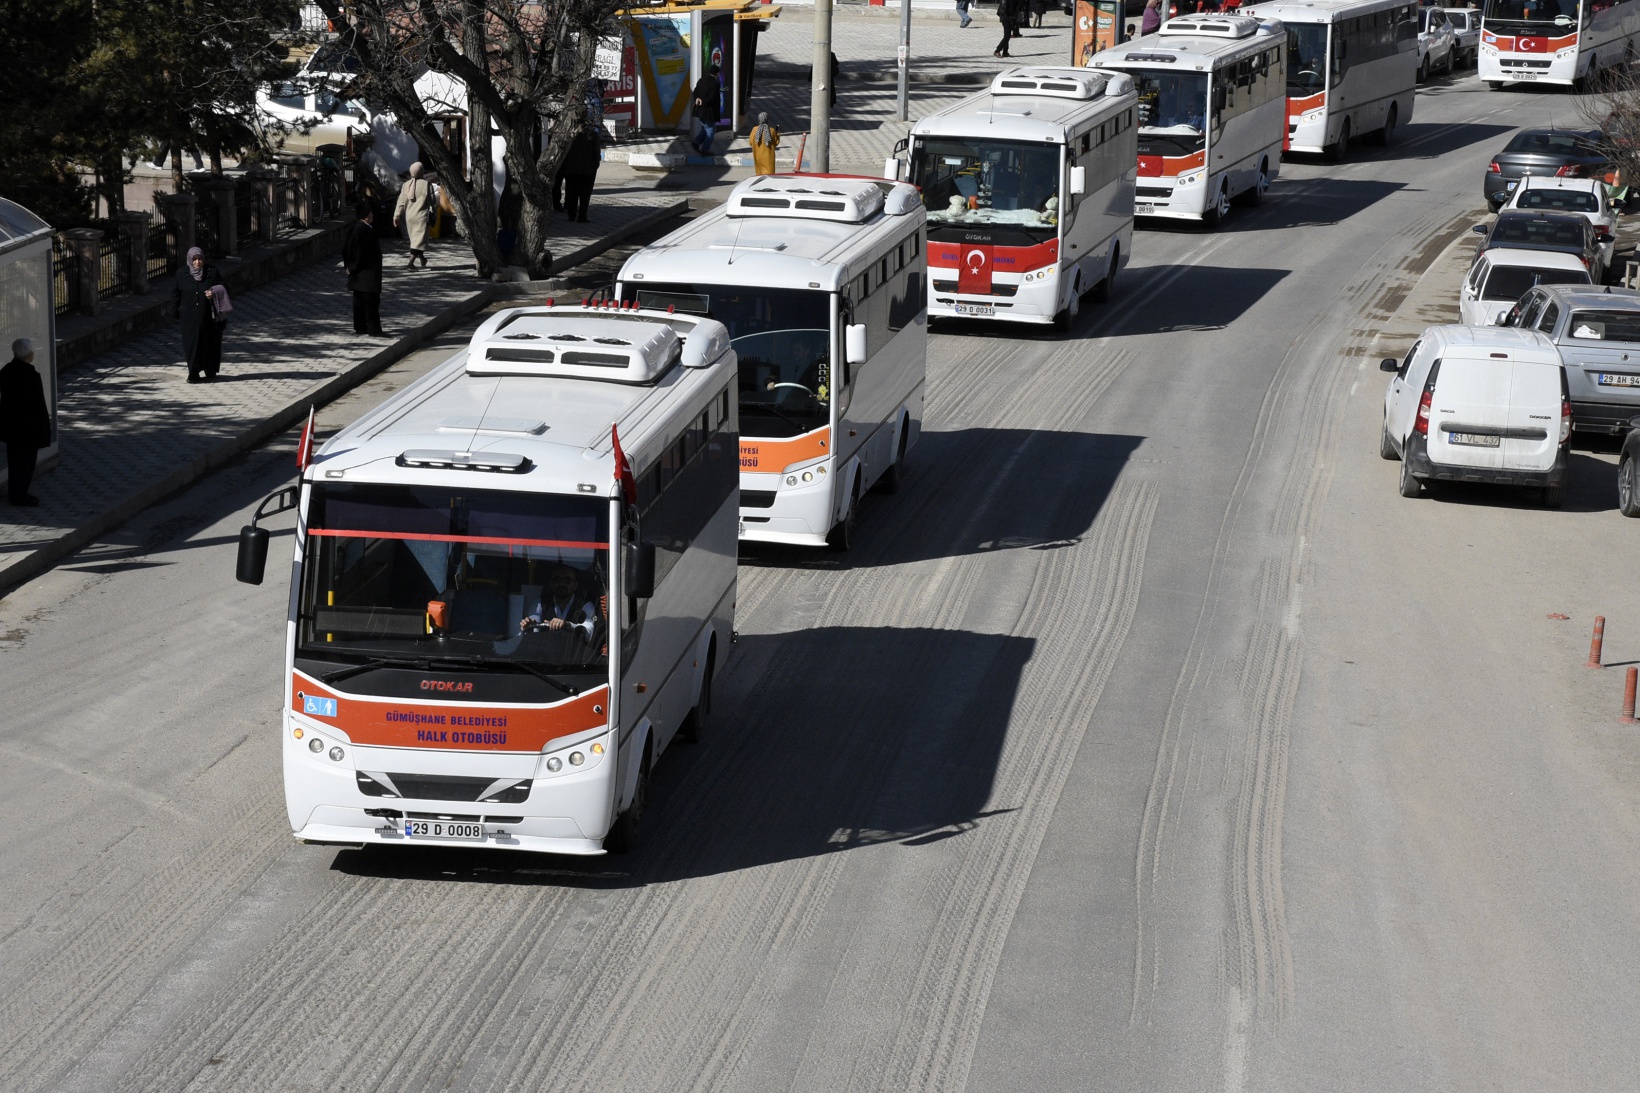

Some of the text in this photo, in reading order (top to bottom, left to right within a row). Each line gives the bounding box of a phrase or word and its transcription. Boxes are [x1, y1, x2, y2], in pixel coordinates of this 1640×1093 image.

[1603, 375, 1614, 383] 29
[1616, 376, 1627, 384] AH
[1453, 433, 1463, 442] 61
[420, 680, 474, 693] OTOKAR
[386, 710, 507, 727] GÜMÜŞHANE BELEDİYESİ
[417, 730, 507, 745] HALK OTOBÜSÜ
[412, 822, 429, 835] 29
[434, 823, 442, 836] D
[447, 824, 480, 837] 0008
